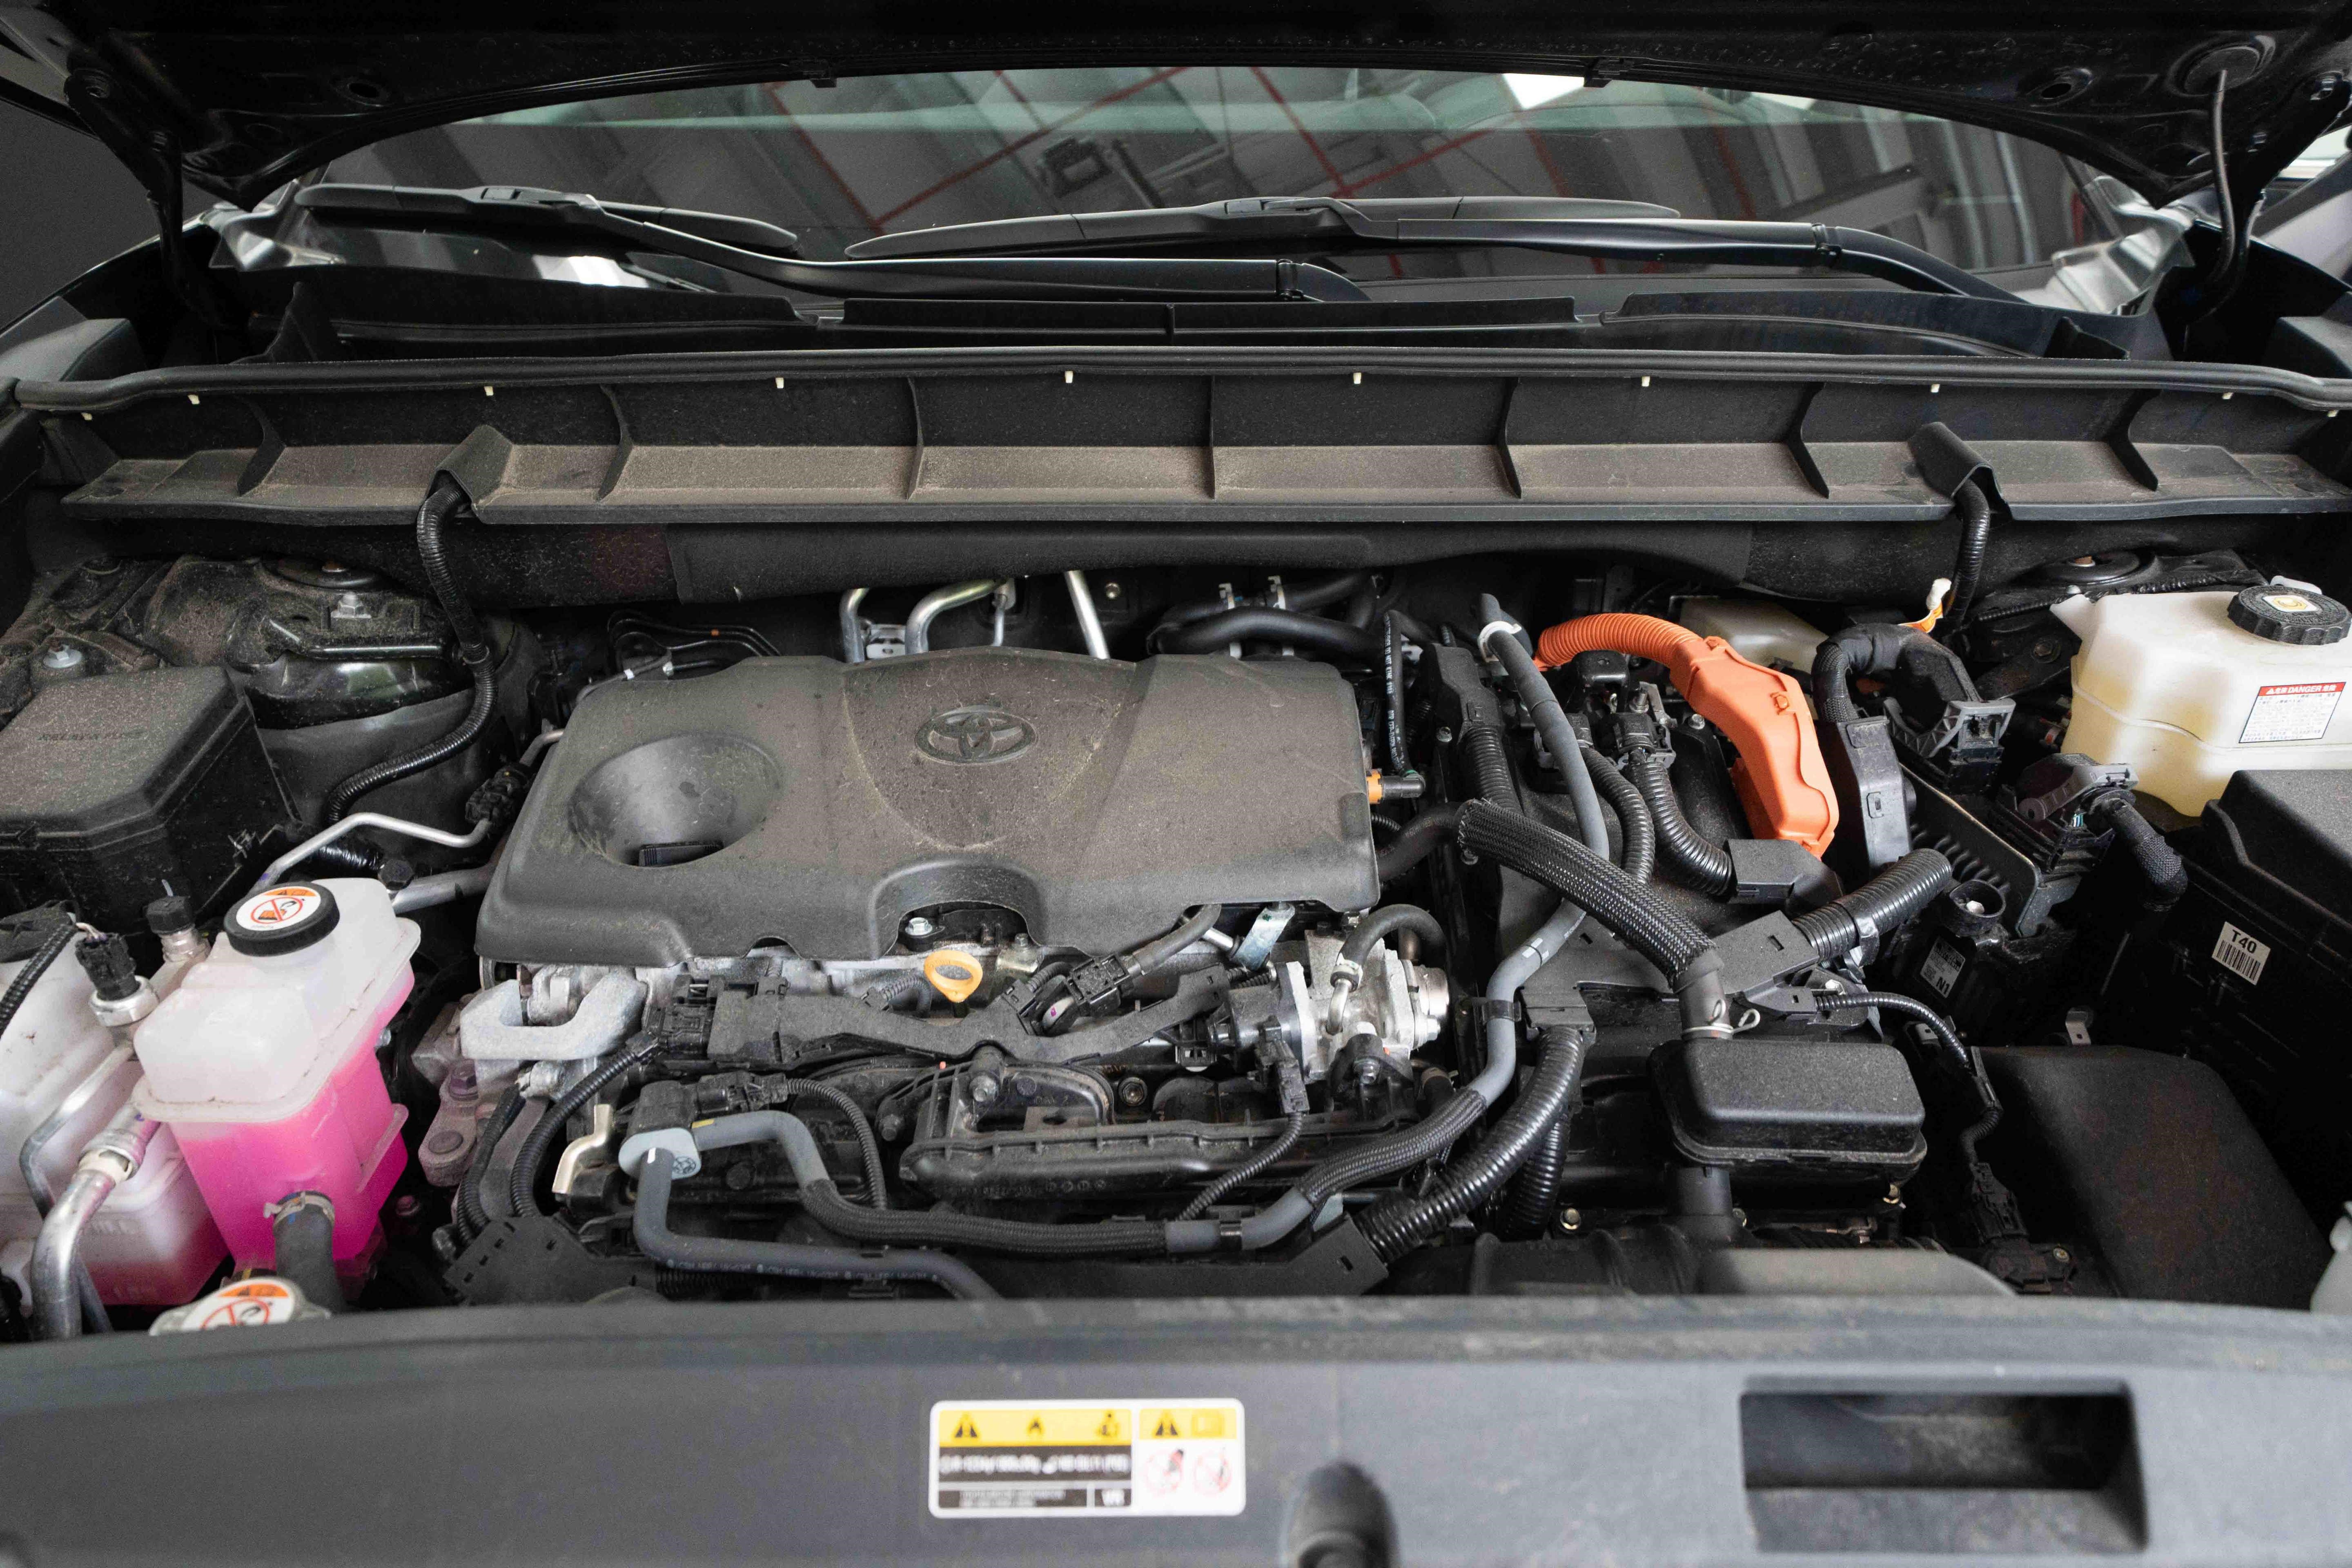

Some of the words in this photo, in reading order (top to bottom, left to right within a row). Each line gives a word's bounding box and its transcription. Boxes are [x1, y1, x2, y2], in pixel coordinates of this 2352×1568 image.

[2287, 685, 2321, 693] DANGER
[2232, 929, 2256, 953] T40
[1936, 977, 1949, 994] N1
